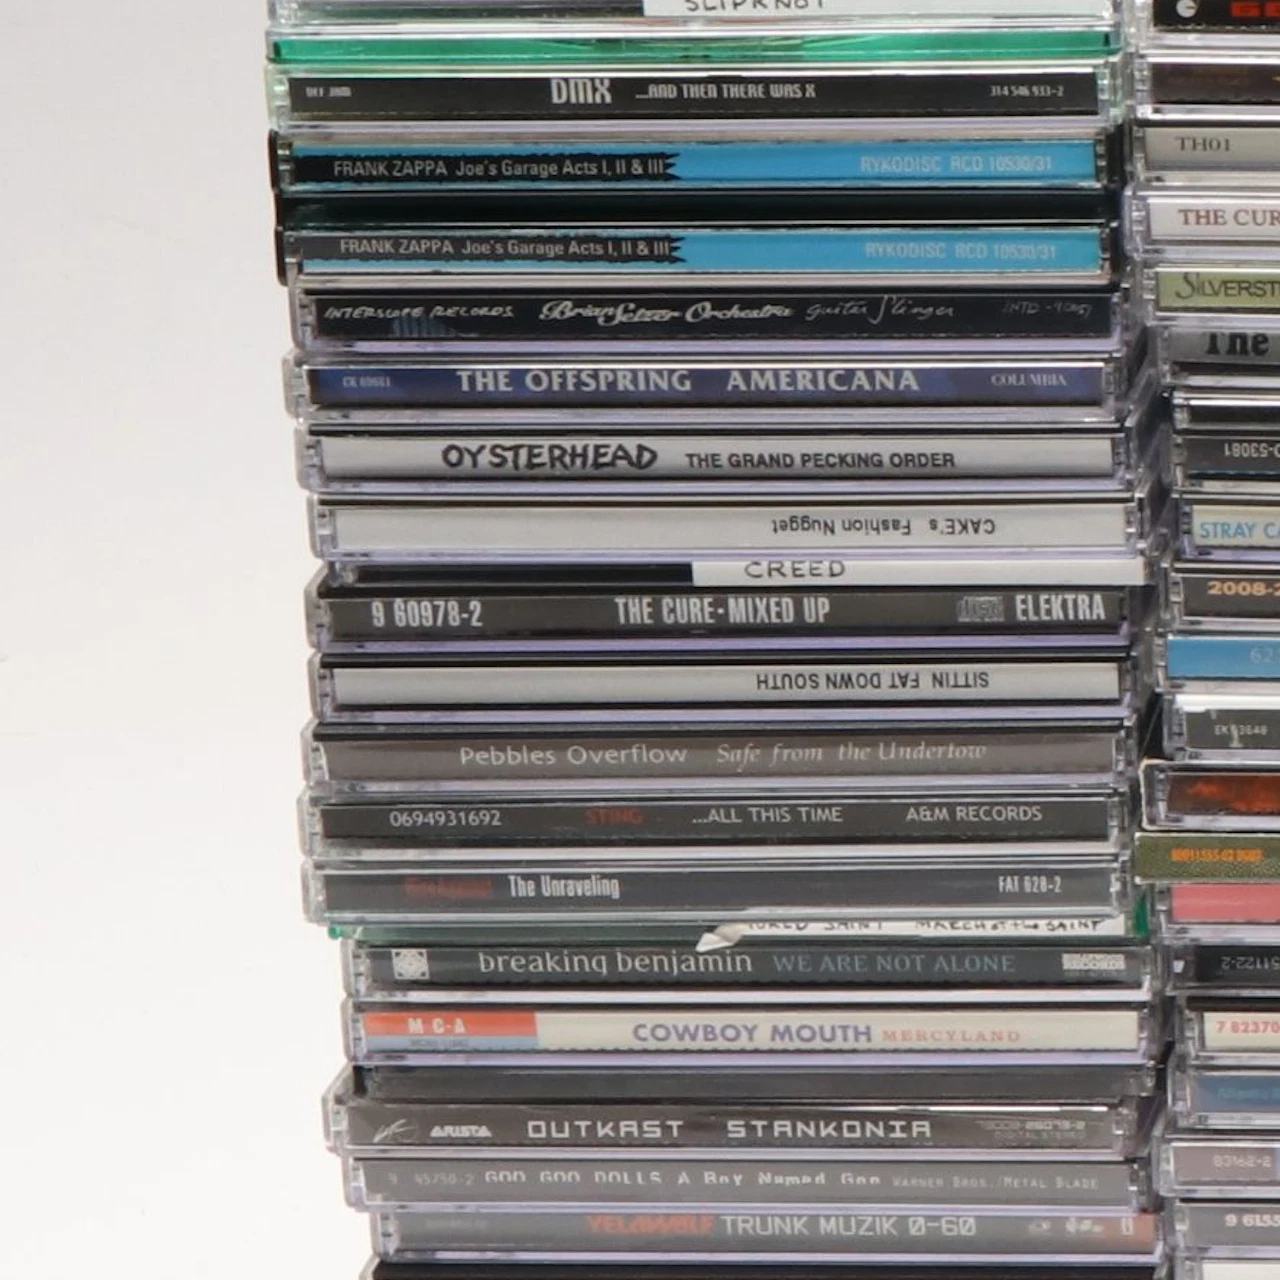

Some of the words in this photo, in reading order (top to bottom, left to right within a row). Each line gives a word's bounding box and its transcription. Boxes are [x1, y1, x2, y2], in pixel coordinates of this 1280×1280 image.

[551, 78, 611, 104] DMX
[682, 84, 717, 98] THEN
[722, 84, 765, 98] THERE
[770, 84, 802, 98] WAS
[805, 84, 815, 97] X
[1181, 138, 1229, 151] TH01
[1178, 209, 1227, 225] THE
[457, 371, 513, 392] THE
[525, 369, 691, 392] OFFSPRING
[727, 368, 918, 392] AMERICANA
[442, 444, 658, 470] OYSTERHEAD
[686, 453, 722, 468] THE
[728, 453, 795, 468] GRAND
[800, 453, 882, 468] PECKING
[888, 453, 955, 468] ORDER
[1199, 523, 1255, 538] STRAY
[745, 561, 844, 578] CREED
[388, 808, 502, 827] 0694931692
[748, 807, 791, 822] THIS
[797, 807, 842, 821] TIME
[633, 1024, 757, 1042] COWBOY
[771, 1025, 871, 1042] MOUTH
[528, 1121, 683, 1137] OUTKAST
[728, 1121, 930, 1137] STANKONIA
